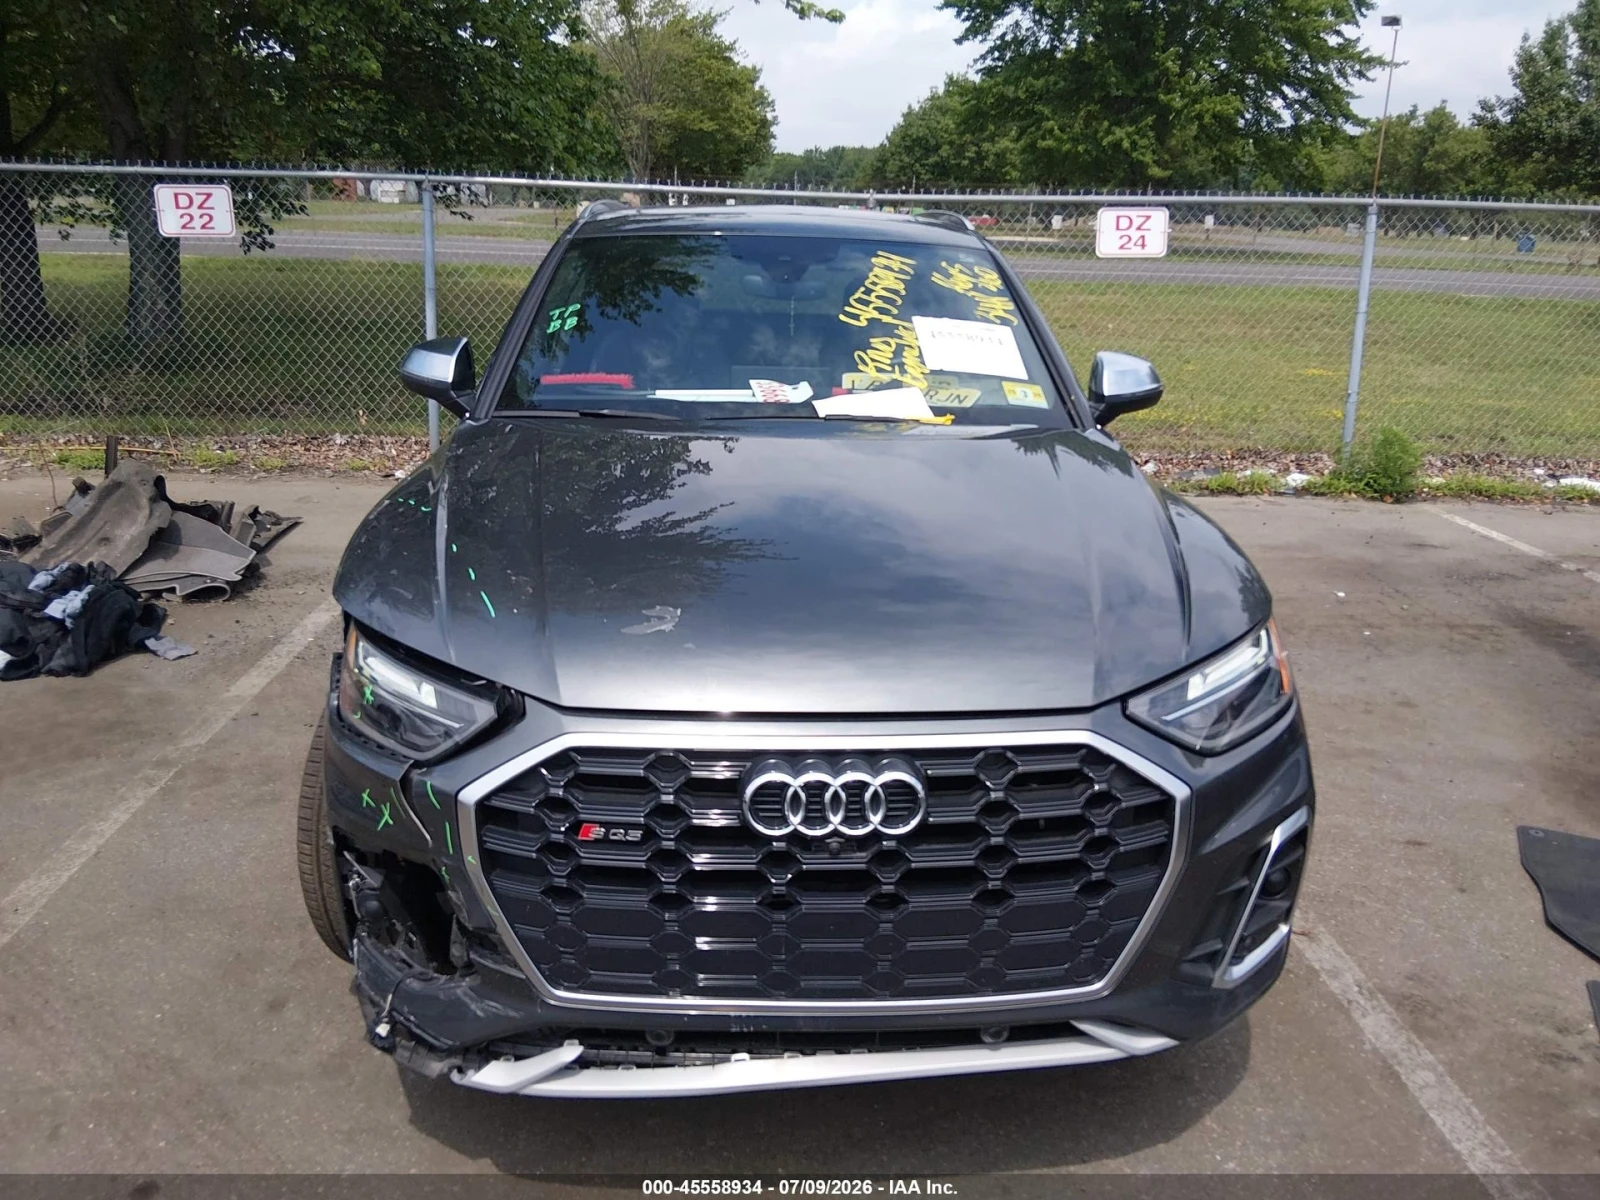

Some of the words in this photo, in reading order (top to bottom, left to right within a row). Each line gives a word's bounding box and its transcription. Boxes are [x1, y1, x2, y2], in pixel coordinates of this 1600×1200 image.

[173, 192, 215, 210] DZ
[179, 212, 215, 230] 22
[1115, 214, 1152, 231] DZ
[1118, 234, 1147, 250] 24
[549, 303, 581, 320] TP
[546, 316, 578, 333] BB
